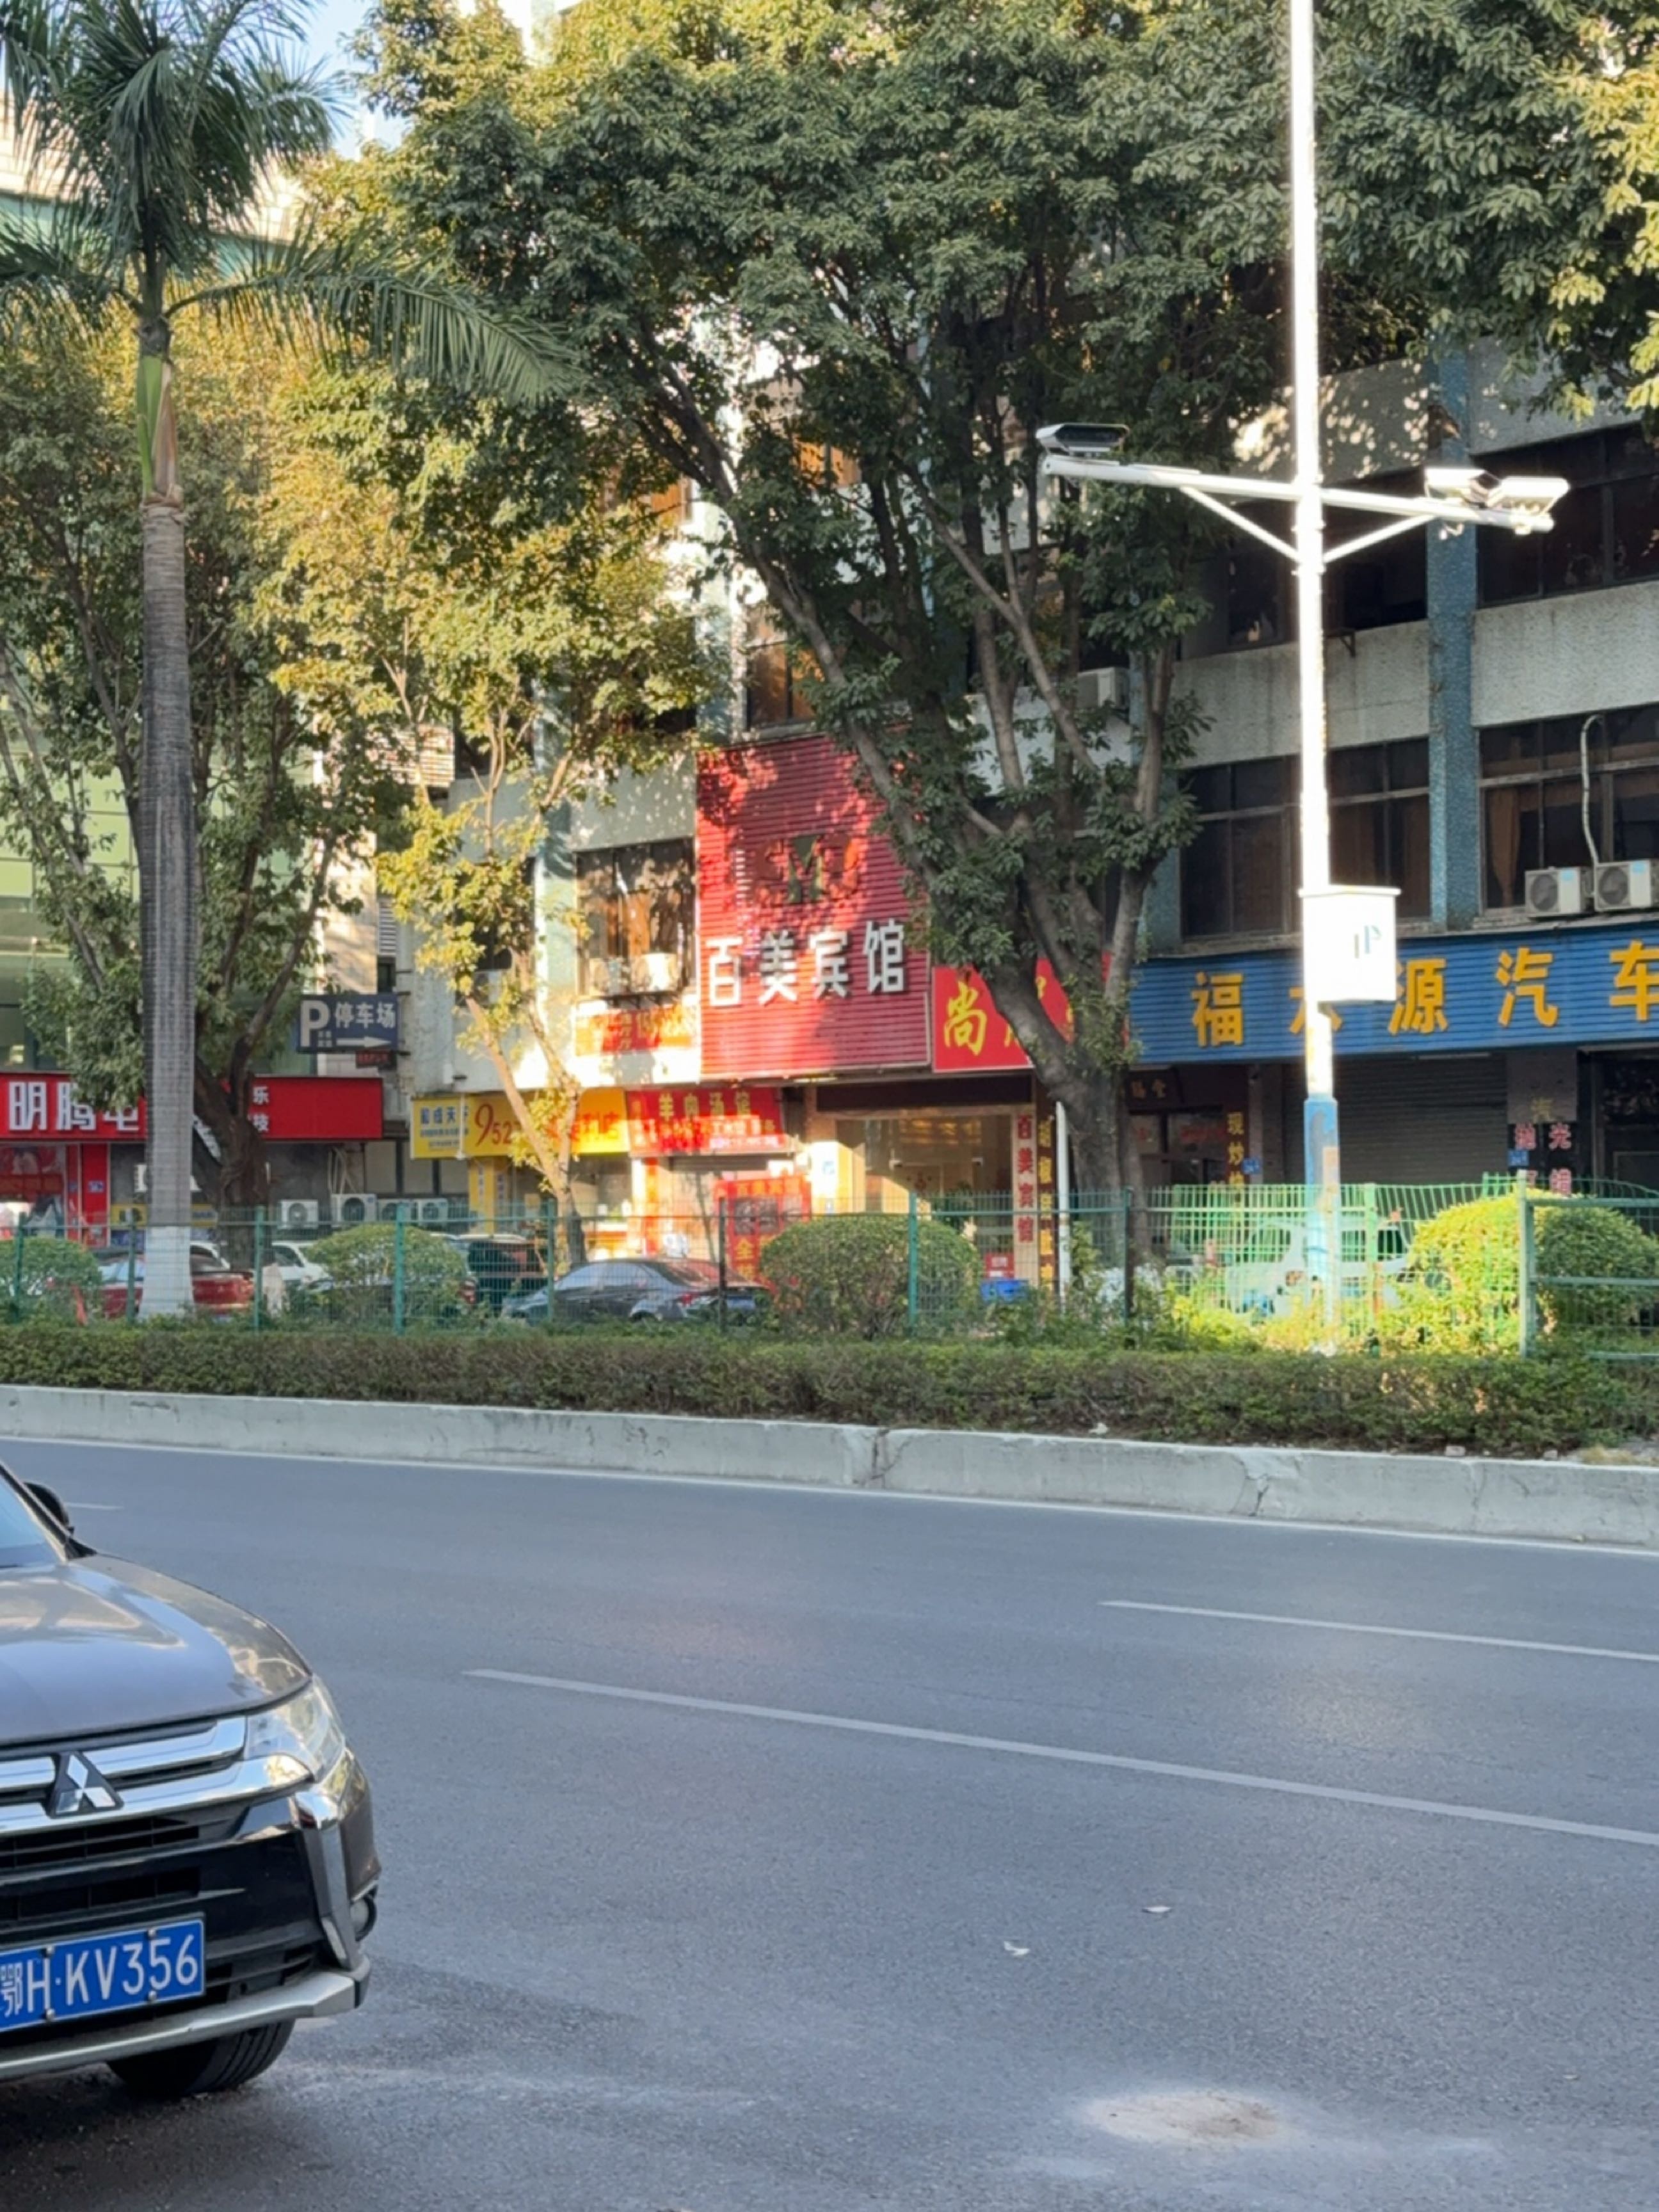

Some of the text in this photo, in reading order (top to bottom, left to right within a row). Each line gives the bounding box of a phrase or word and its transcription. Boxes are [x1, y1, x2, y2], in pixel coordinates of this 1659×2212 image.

[705, 918, 906, 1007] 百美宾馆
[335, 1001, 396, 1029] 停车场
[1017, 1114, 1034, 1244] 百美宾馆
[1, 1934, 198, 2016] 鄂H·KV356
